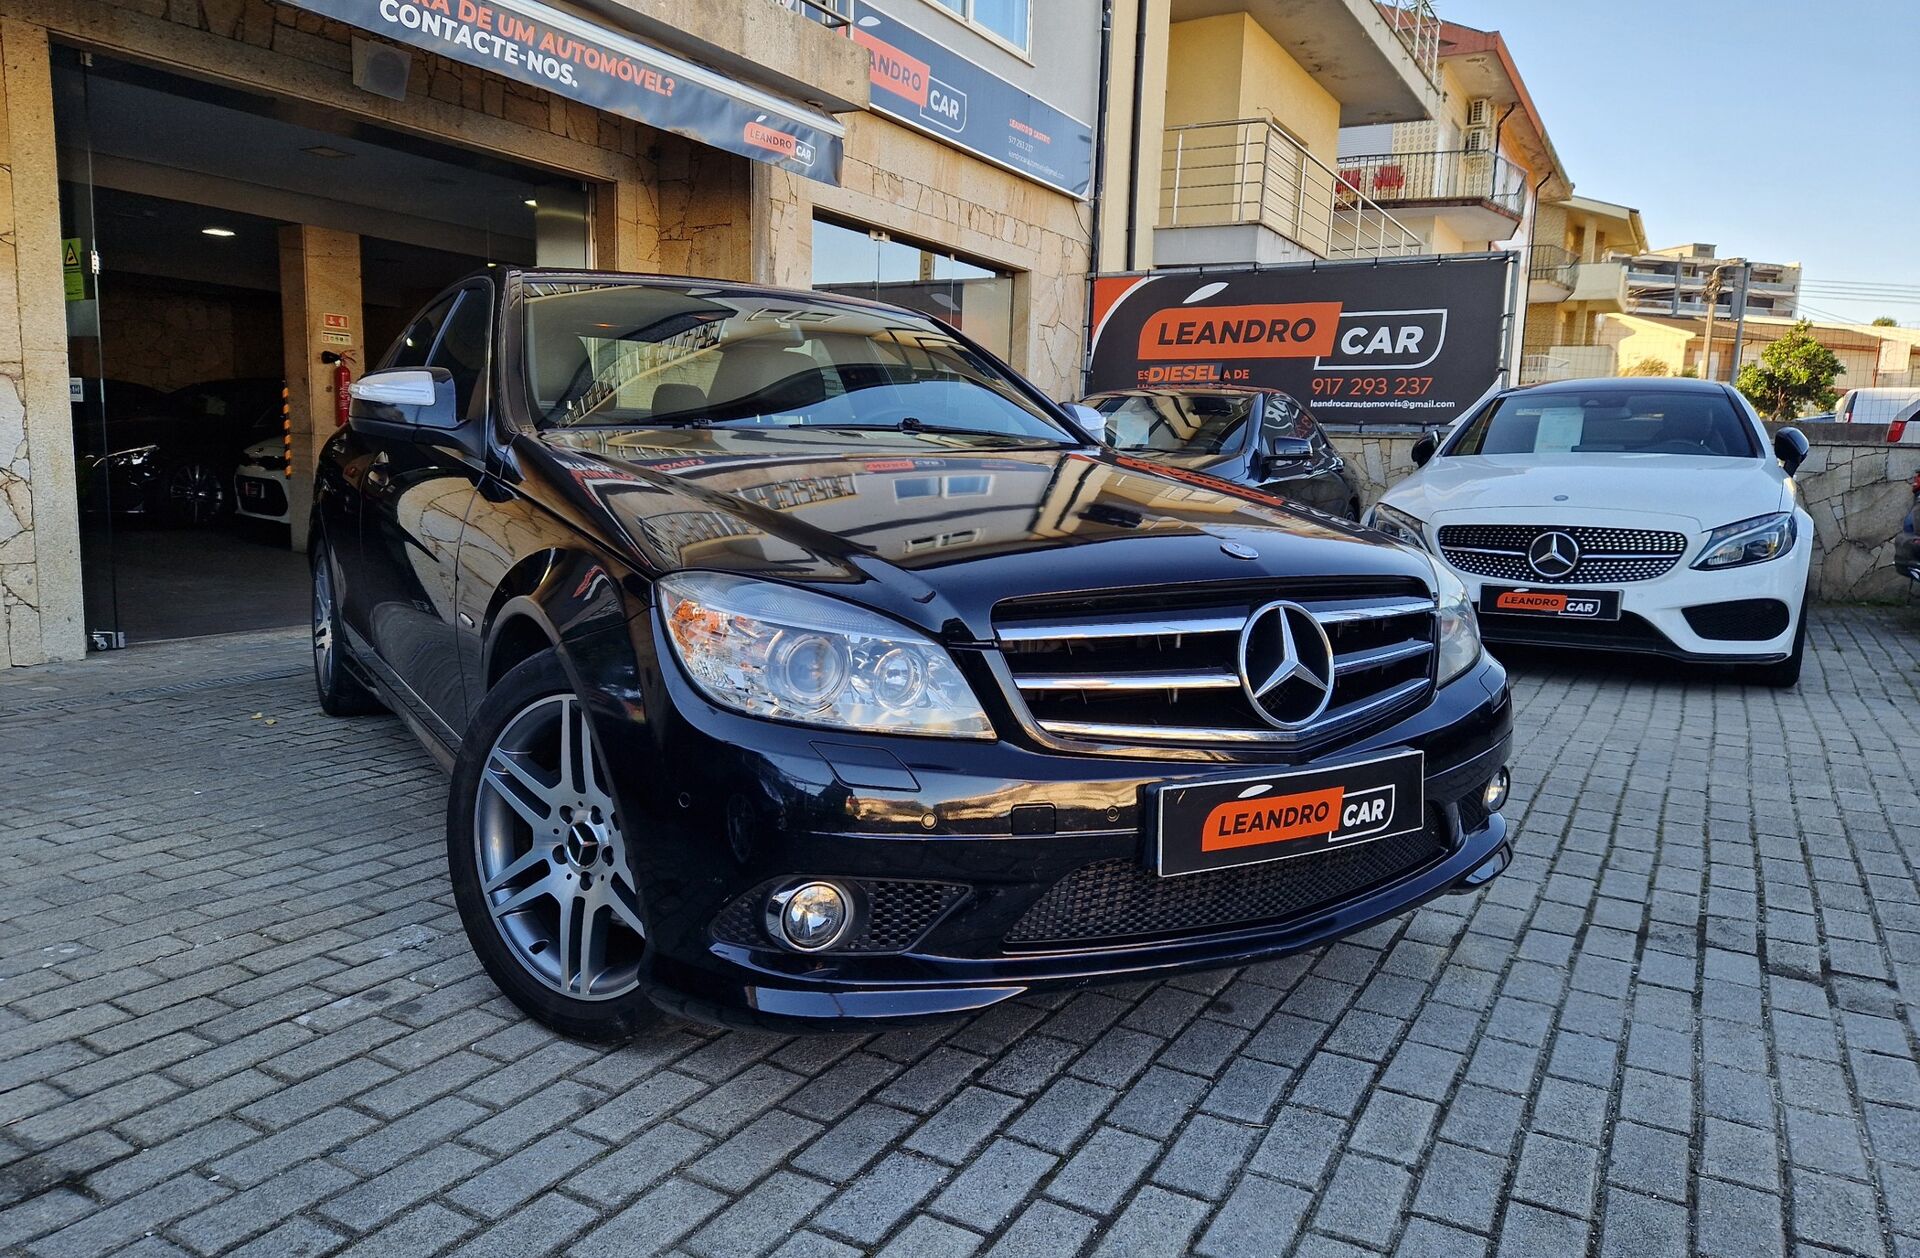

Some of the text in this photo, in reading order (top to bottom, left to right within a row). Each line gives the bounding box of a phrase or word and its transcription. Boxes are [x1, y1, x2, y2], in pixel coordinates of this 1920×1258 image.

[379, 0, 578, 88] CONTACTE-NOS.
[457, 0, 493, 31] DE
[498, 14, 535, 46] UM
[539, 32, 675, 97] AUTOMÓVEL?
[930, 89, 960, 121] CAR
[750, 128, 812, 159] LEANDRO CAR
[1157, 318, 1425, 355] LEANDRO CAR
[1148, 365, 1220, 382] DIESEL
[1234, 369, 1250, 380] DE
[1311, 377, 1433, 395] 917 293 237
[1310, 399, 1456, 409] leandrocarautomoveis@gmail.com
[1504, 596, 1594, 613] LEANDRO CAR
[1218, 798, 1386, 837] LEANDRO CAR
